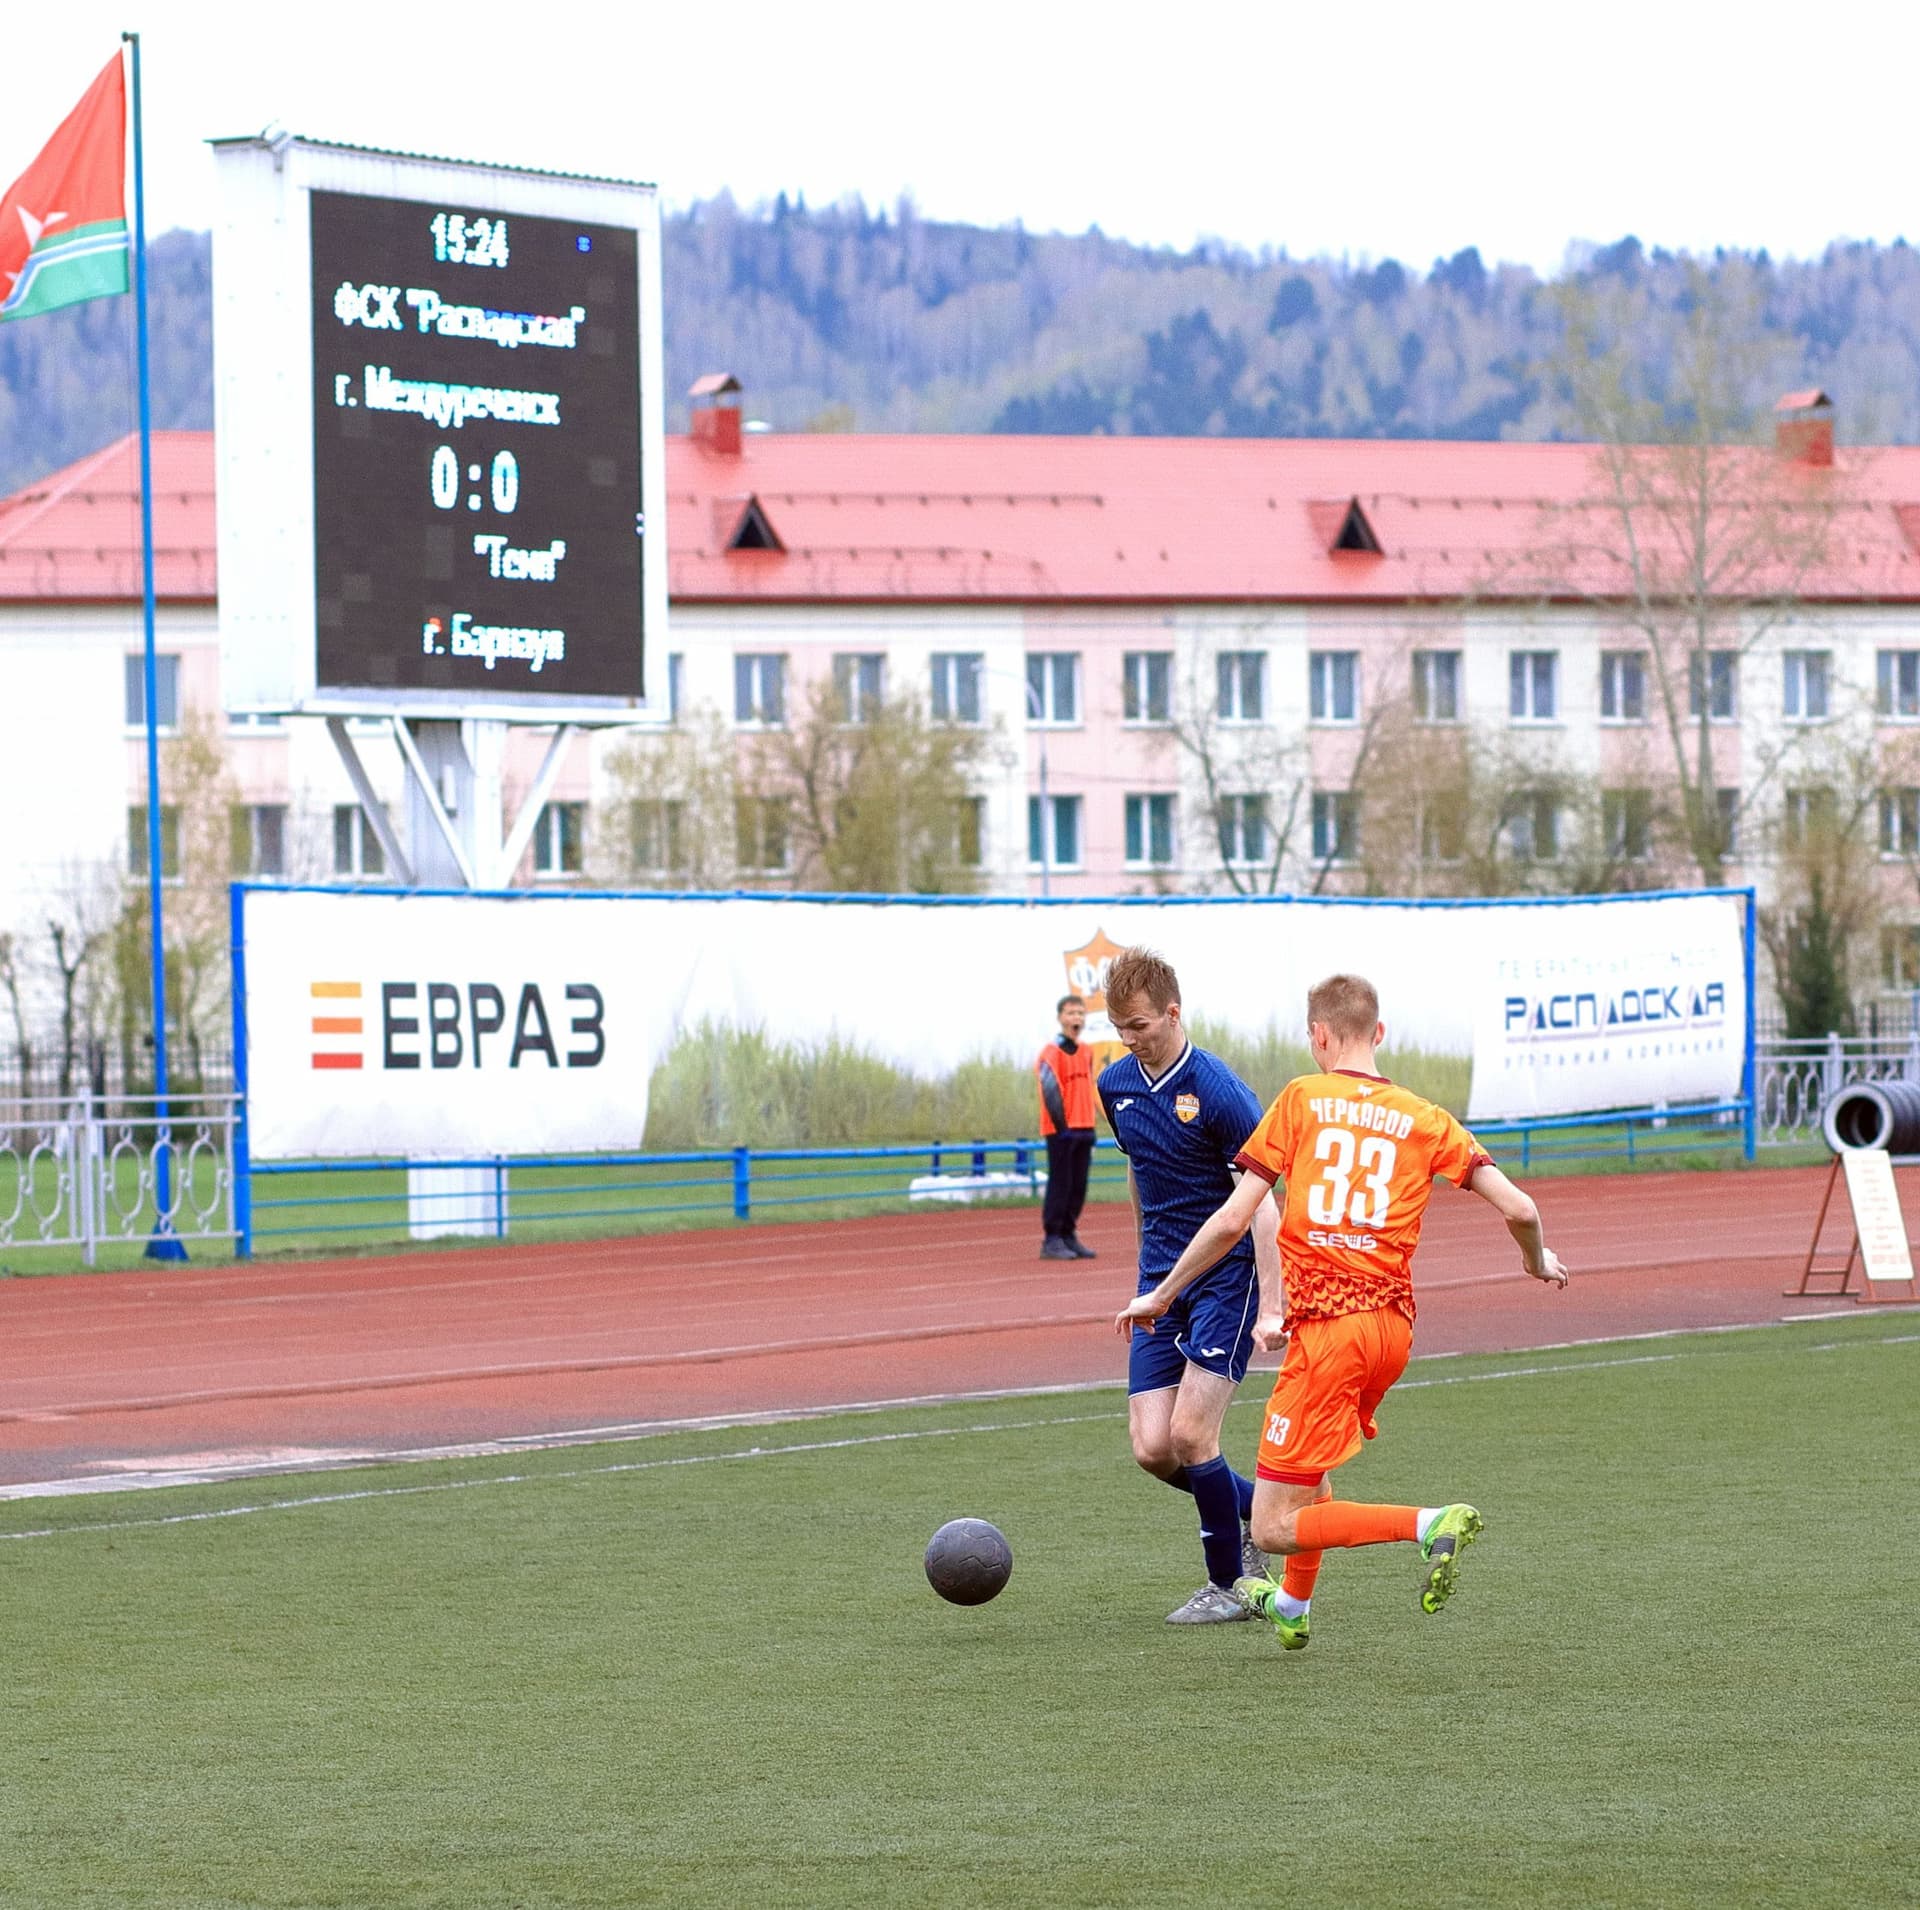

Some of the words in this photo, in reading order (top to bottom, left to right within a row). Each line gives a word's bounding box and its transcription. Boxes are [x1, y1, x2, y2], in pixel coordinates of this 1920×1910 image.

[429, 212, 510, 269] 15:24
[334, 281, 404, 331] ФСК
[335, 374, 359, 407] г.
[423, 621, 446, 655] г.
[381, 981, 606, 1070] ЕВРАЗ
[1309, 1097, 1415, 1140] ЧЕРКАСОВ
[1307, 1127, 1397, 1230] 33
[1266, 1413, 1291, 1446] 33
